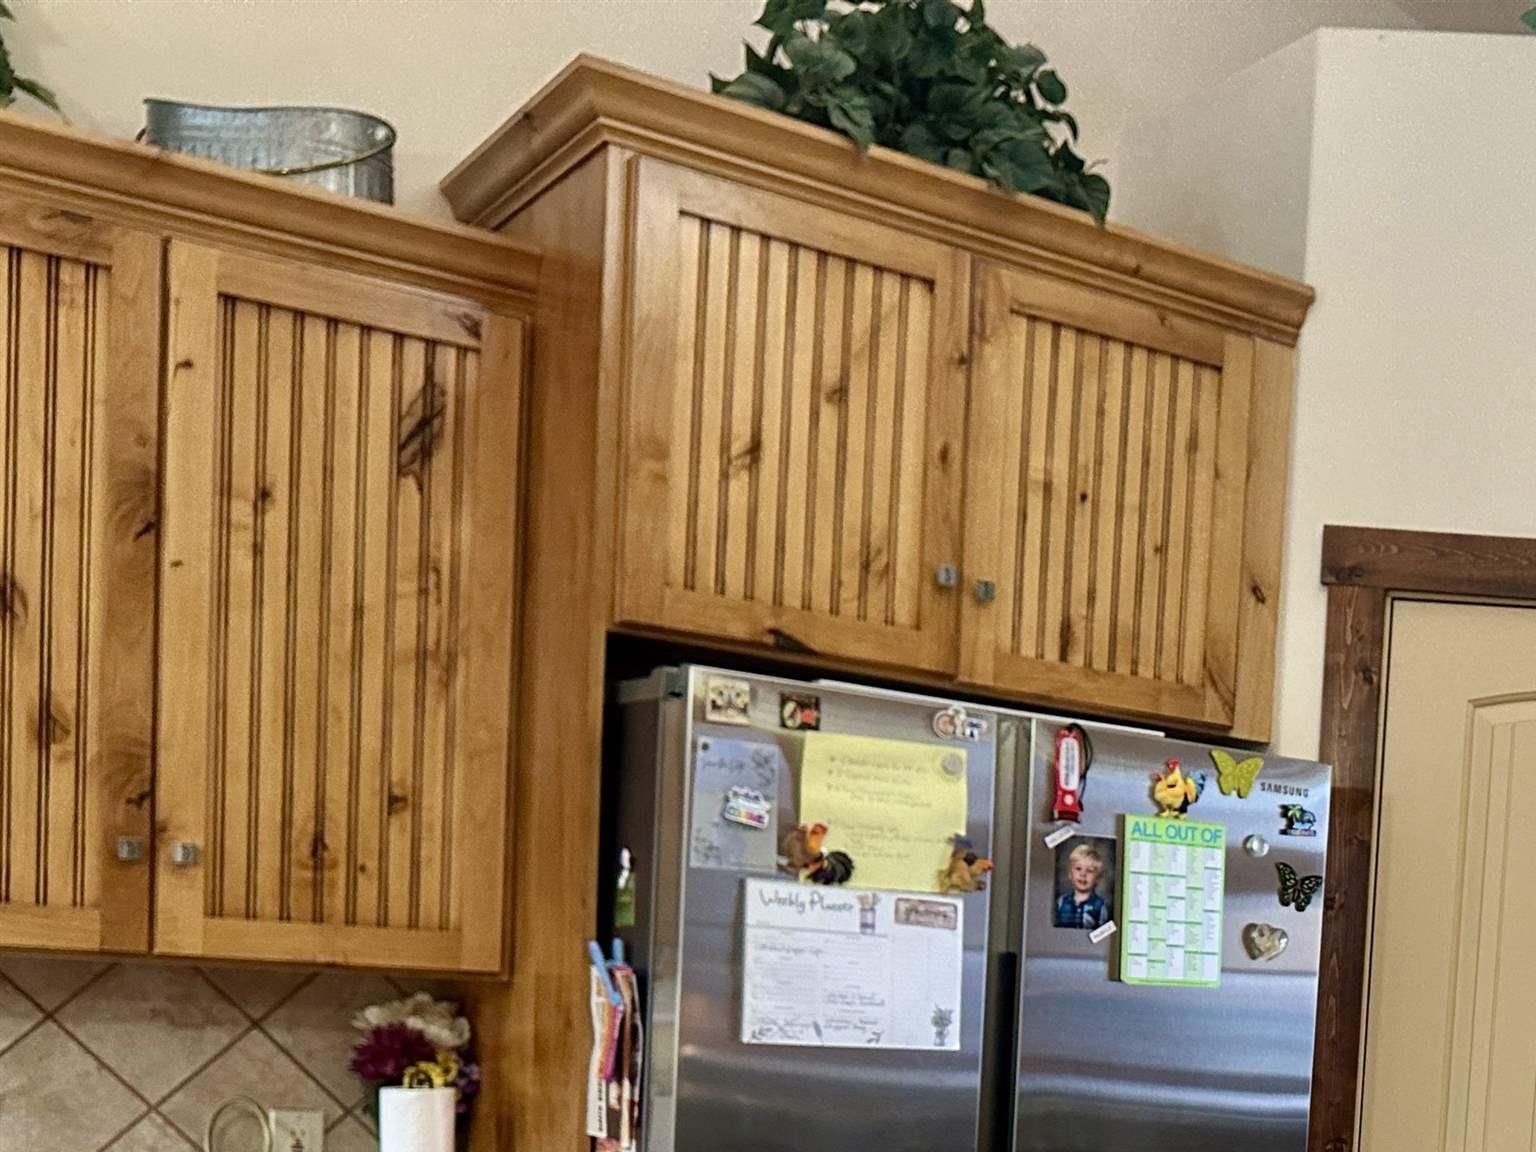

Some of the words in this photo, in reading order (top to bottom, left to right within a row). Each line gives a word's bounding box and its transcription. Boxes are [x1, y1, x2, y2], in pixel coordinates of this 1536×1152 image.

[1260, 782, 1310, 798] SAMSUNG
[1131, 821, 1162, 838] ALL
[1165, 824, 1198, 842] OUT
[1201, 828, 1223, 844] OF
[759, 888, 805, 915] Weekly
